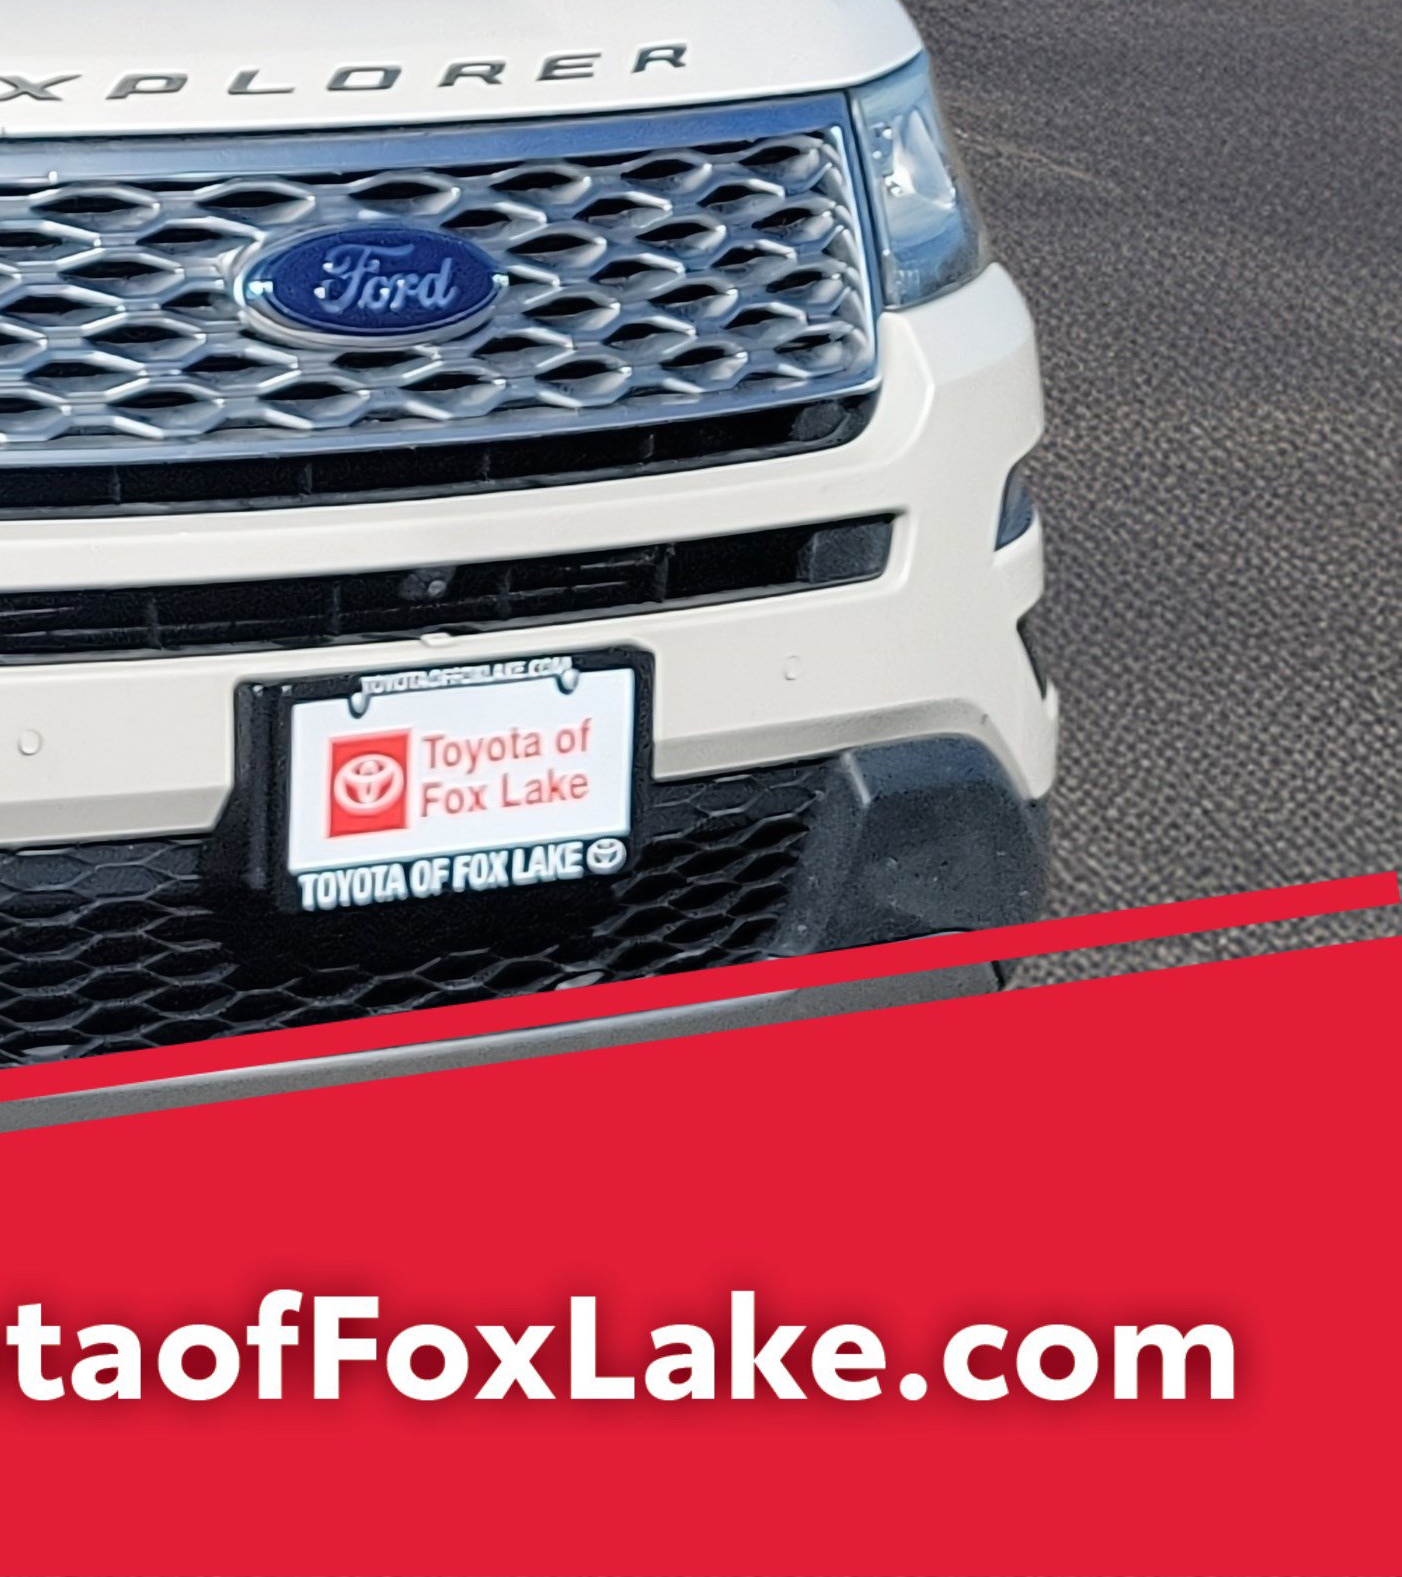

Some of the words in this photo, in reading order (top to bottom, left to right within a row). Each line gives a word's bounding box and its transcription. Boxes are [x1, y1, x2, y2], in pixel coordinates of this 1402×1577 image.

[314, 243, 460, 313] Ford
[420, 727, 543, 774] Toyota
[554, 717, 593, 754] of
[419, 777, 488, 818] Fox
[500, 768, 590, 808] Lake
[299, 862, 409, 911] TOYOTA
[409, 857, 451, 899] OF
[452, 849, 509, 893] FOX
[511, 840, 585, 886] LAKE
